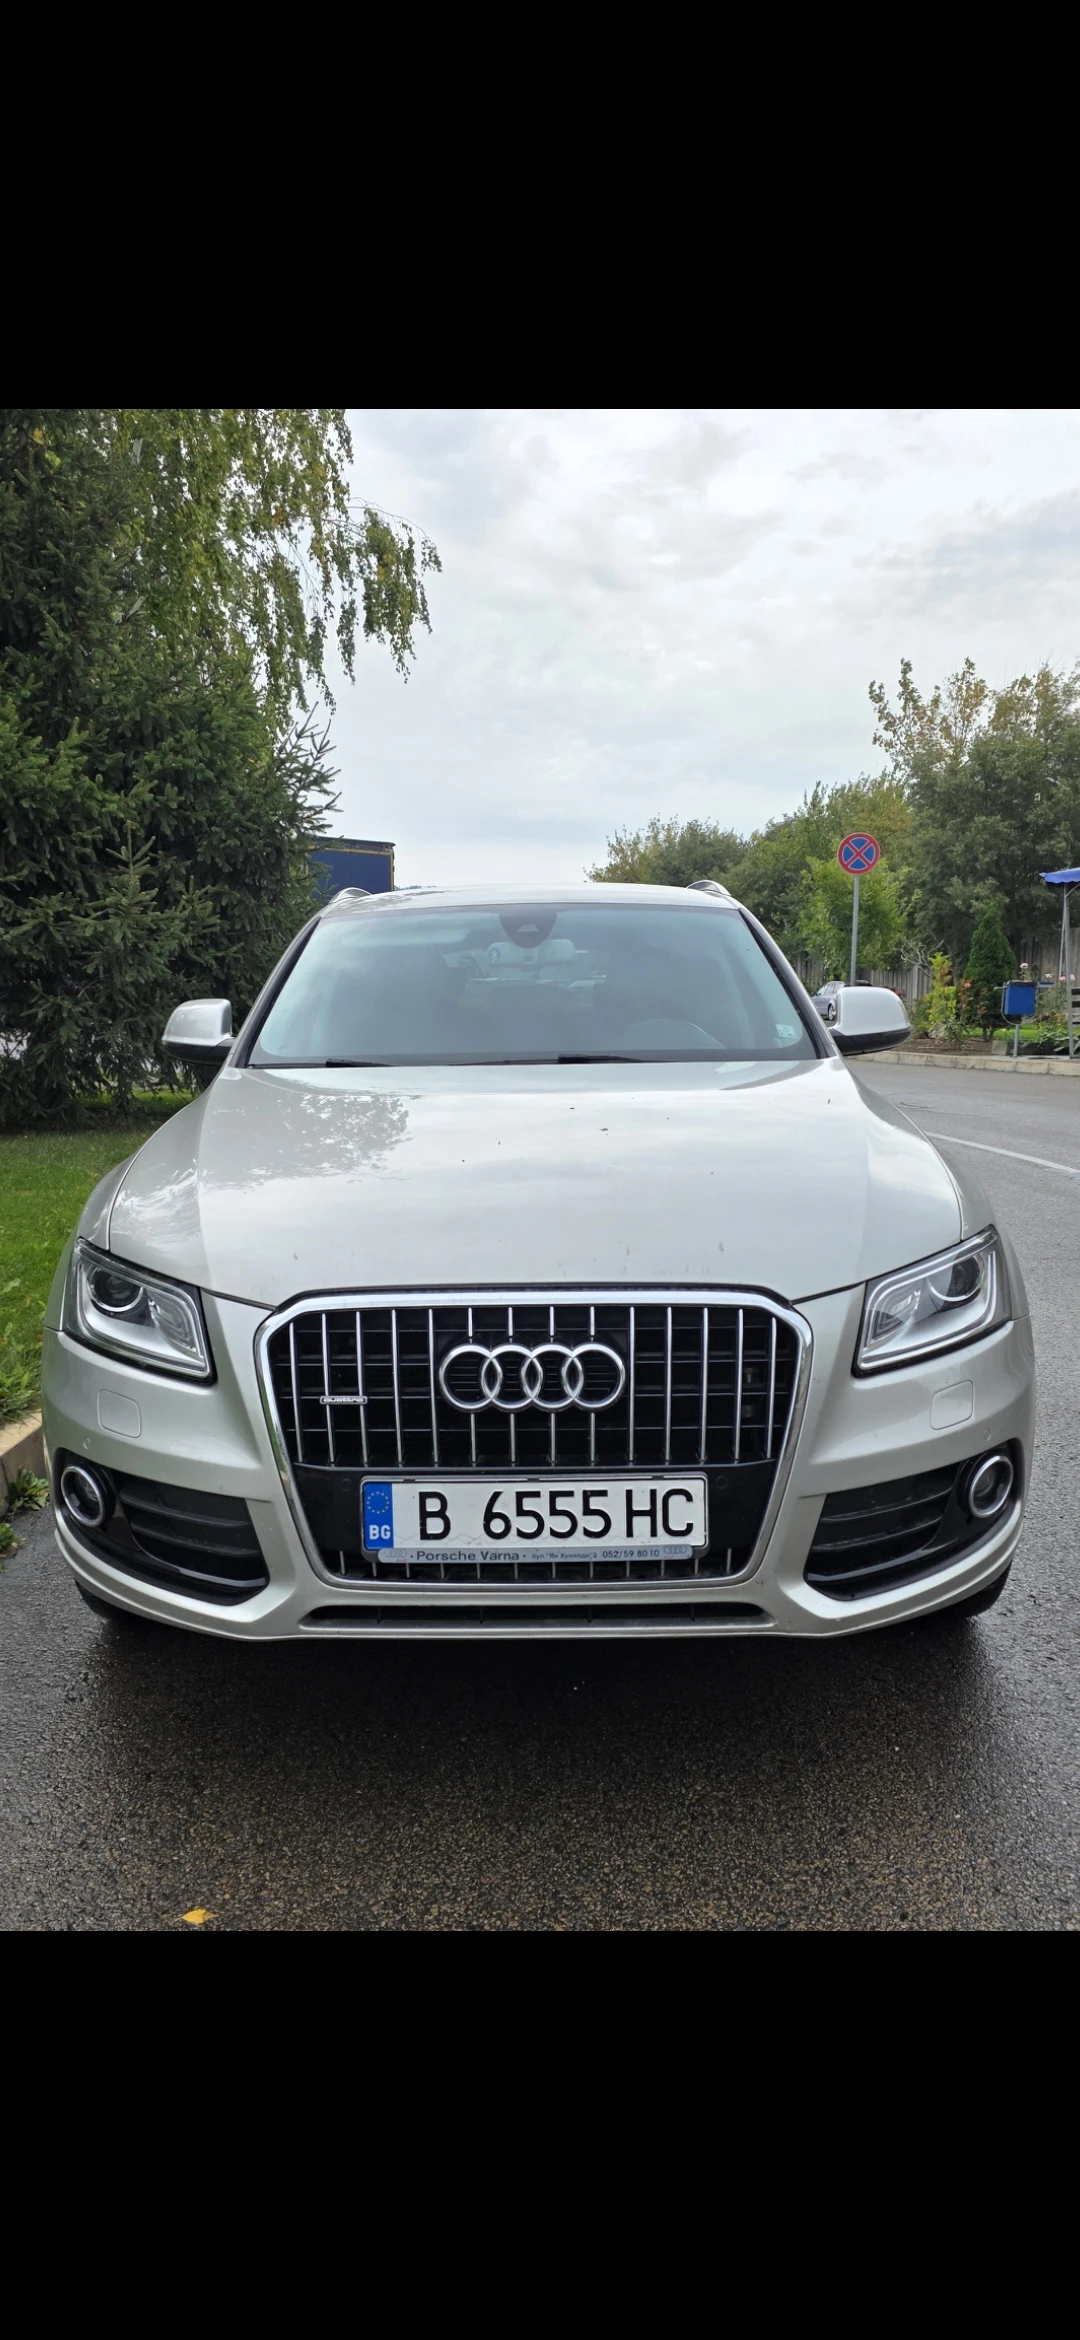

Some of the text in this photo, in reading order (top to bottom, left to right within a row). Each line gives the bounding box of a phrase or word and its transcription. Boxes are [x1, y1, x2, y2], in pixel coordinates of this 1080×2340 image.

[418, 1488, 694, 1540] B 6555 HC
[369, 1524, 391, 1540] BG
[416, 1550, 476, 1561] Porsche
[480, 1550, 520, 1561] Varna
[602, 1549, 634, 1559] 052/59
[636, 1549, 648, 1558] 80
[650, 1548, 660, 1557] 10
